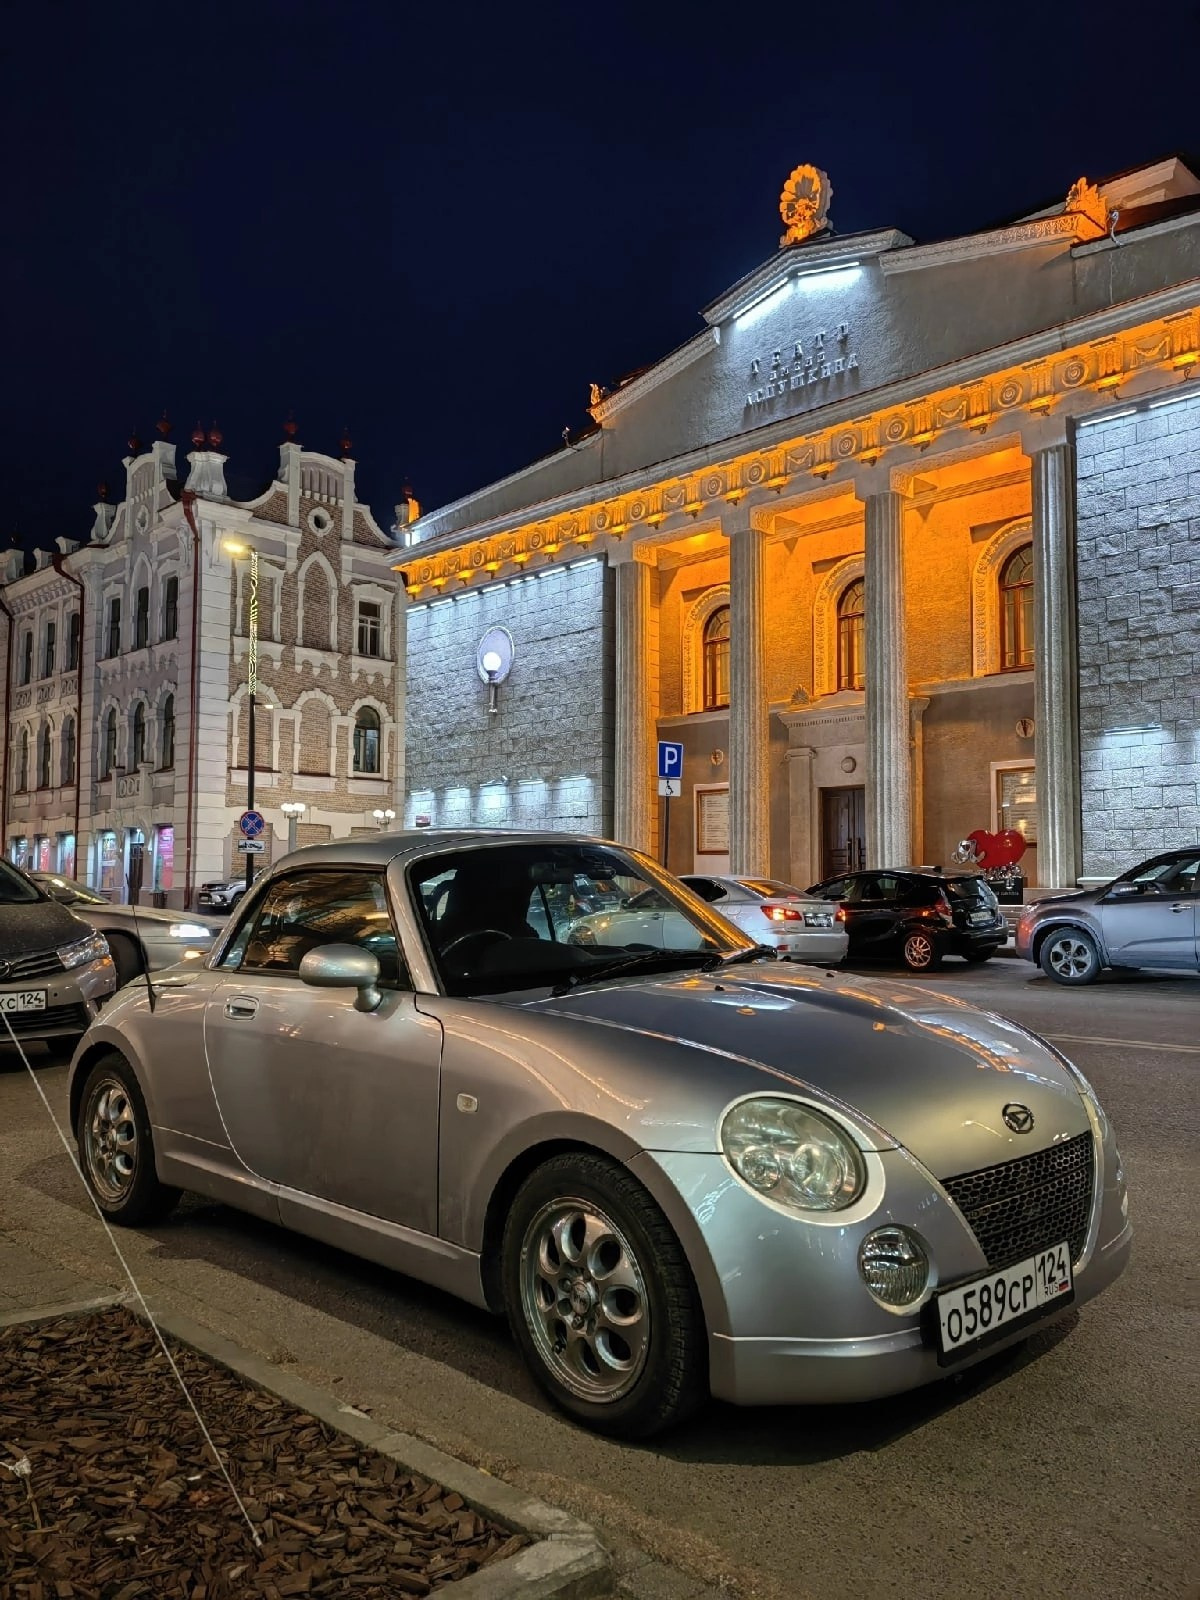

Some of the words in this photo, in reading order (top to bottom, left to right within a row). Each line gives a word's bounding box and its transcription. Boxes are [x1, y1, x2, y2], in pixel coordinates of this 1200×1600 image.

[751, 322, 849, 373] ТЕАТР
[665, 747, 678, 774] P
[20, 993, 44, 1005] 124
[1038, 1247, 1067, 1286] 124
[1044, 1283, 1058, 1296] RUS
